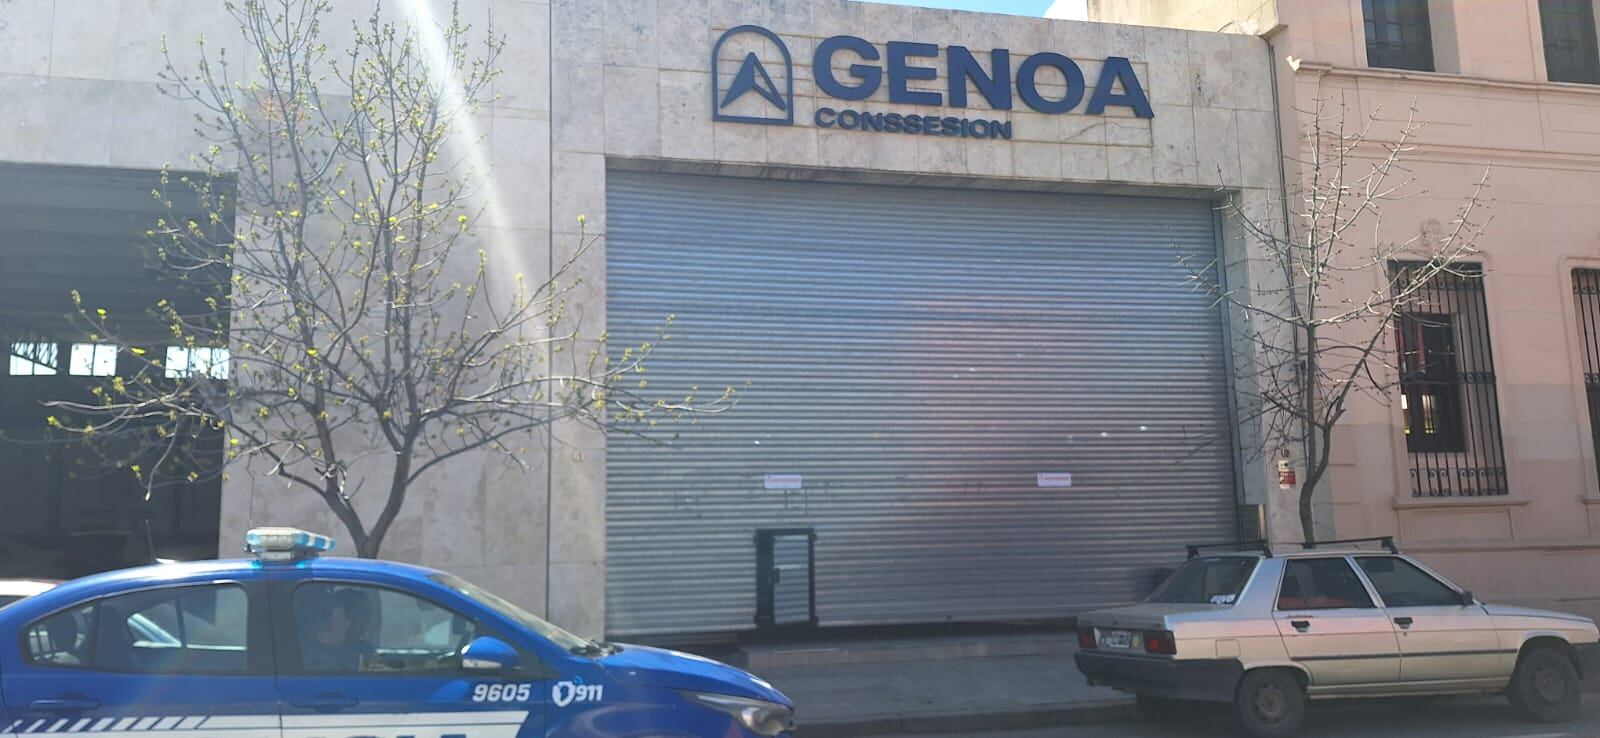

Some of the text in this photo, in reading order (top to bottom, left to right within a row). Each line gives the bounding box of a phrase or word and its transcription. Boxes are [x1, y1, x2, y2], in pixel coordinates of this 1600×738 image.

[814, 35, 1154, 119] GENOA
[814, 108, 1012, 140] CONSSESION
[472, 684, 532, 702] 9605
[575, 684, 604, 702] 911
